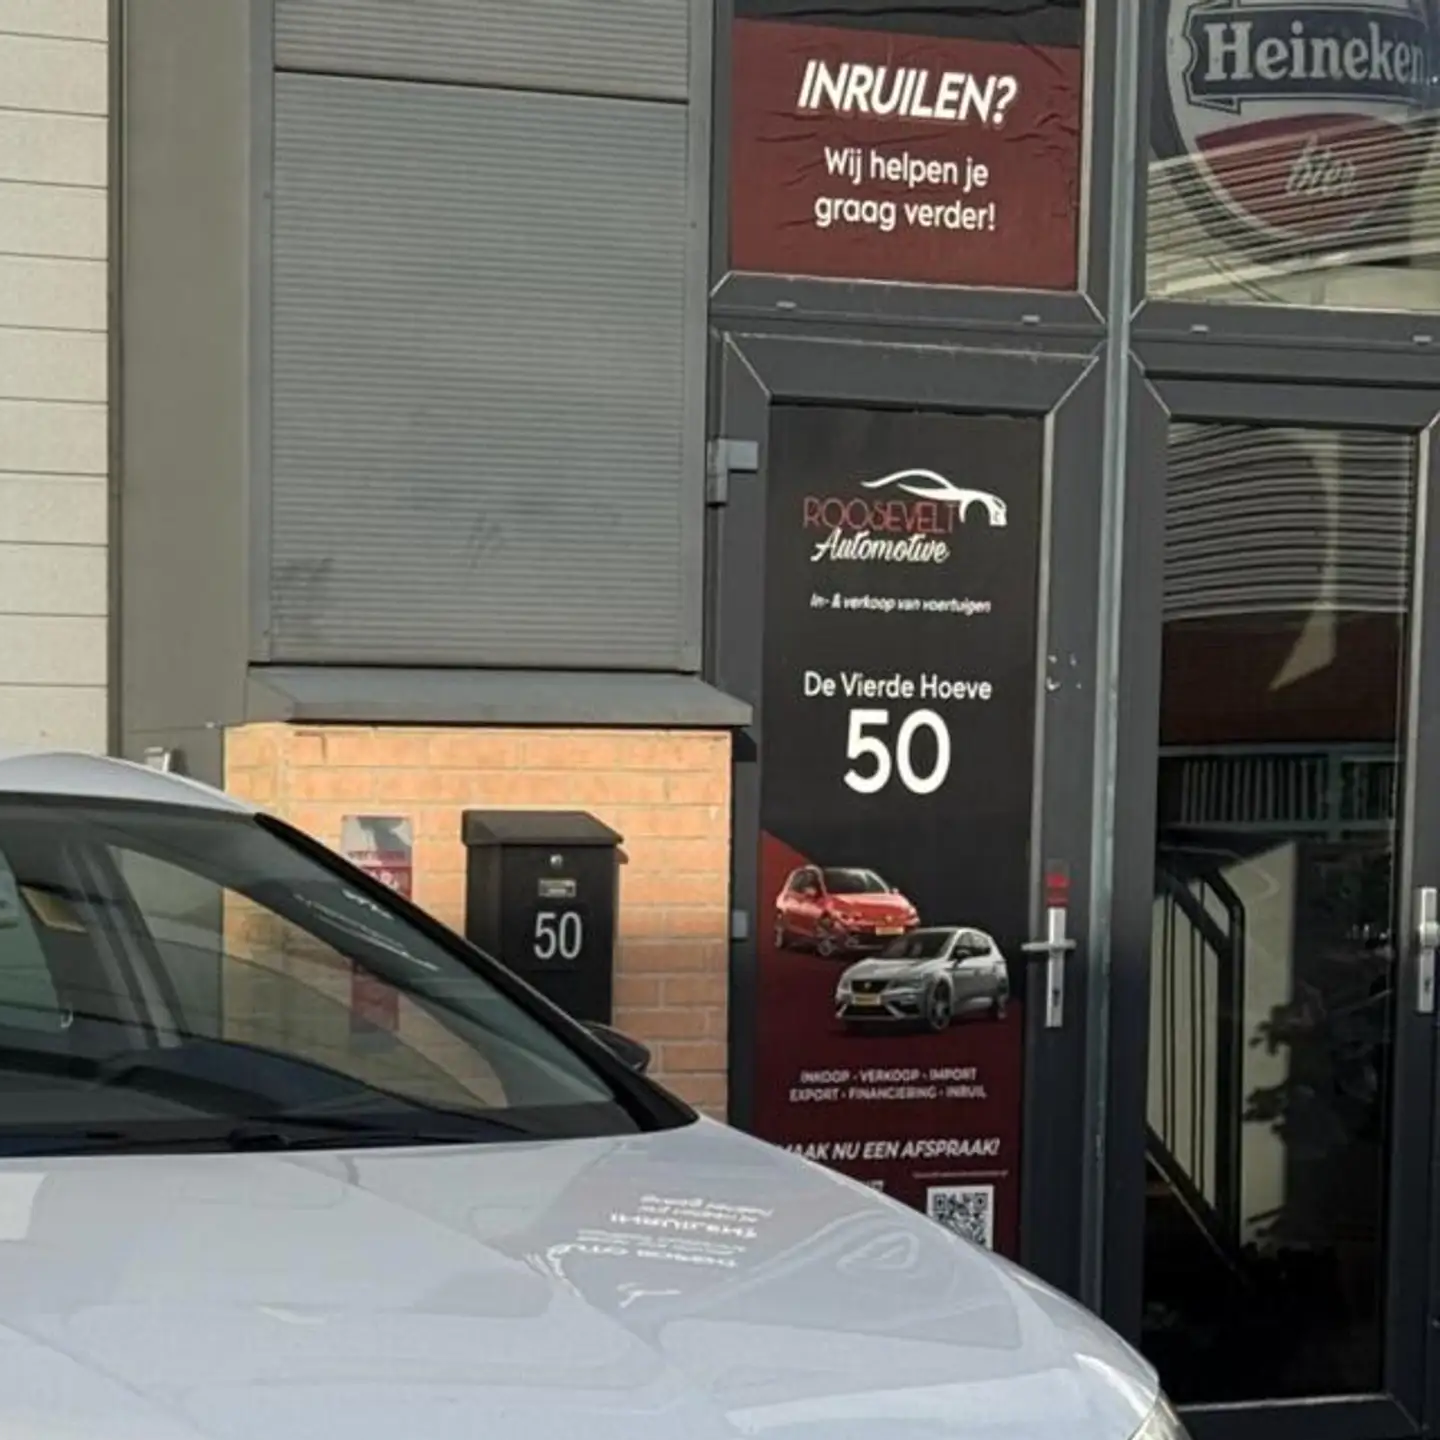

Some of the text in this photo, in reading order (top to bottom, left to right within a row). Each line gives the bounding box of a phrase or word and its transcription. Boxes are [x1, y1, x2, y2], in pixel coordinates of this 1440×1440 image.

[1203, 20, 1425, 85] Heineken
[797, 59, 1018, 124] INRUILEN?
[824, 146, 989, 193] Wij helpen je
[814, 196, 996, 231] graag verder!
[803, 496, 957, 534] ROOSEVELT
[810, 527, 950, 563] Automotive
[843, 594, 896, 612] verkoop
[897, 597, 921, 611] van
[922, 597, 992, 616] voertuigen
[804, 670, 992, 699] De Vierde Hoeve
[843, 708, 951, 794] 50
[534, 911, 582, 959] 50
[800, 1067, 977, 1083] INKOOP VERKOOP IMPORT
[789, 1087, 839, 1102] EXPORT
[831, 1141, 860, 1160] NU
[862, 1140, 900, 1160] EEN
